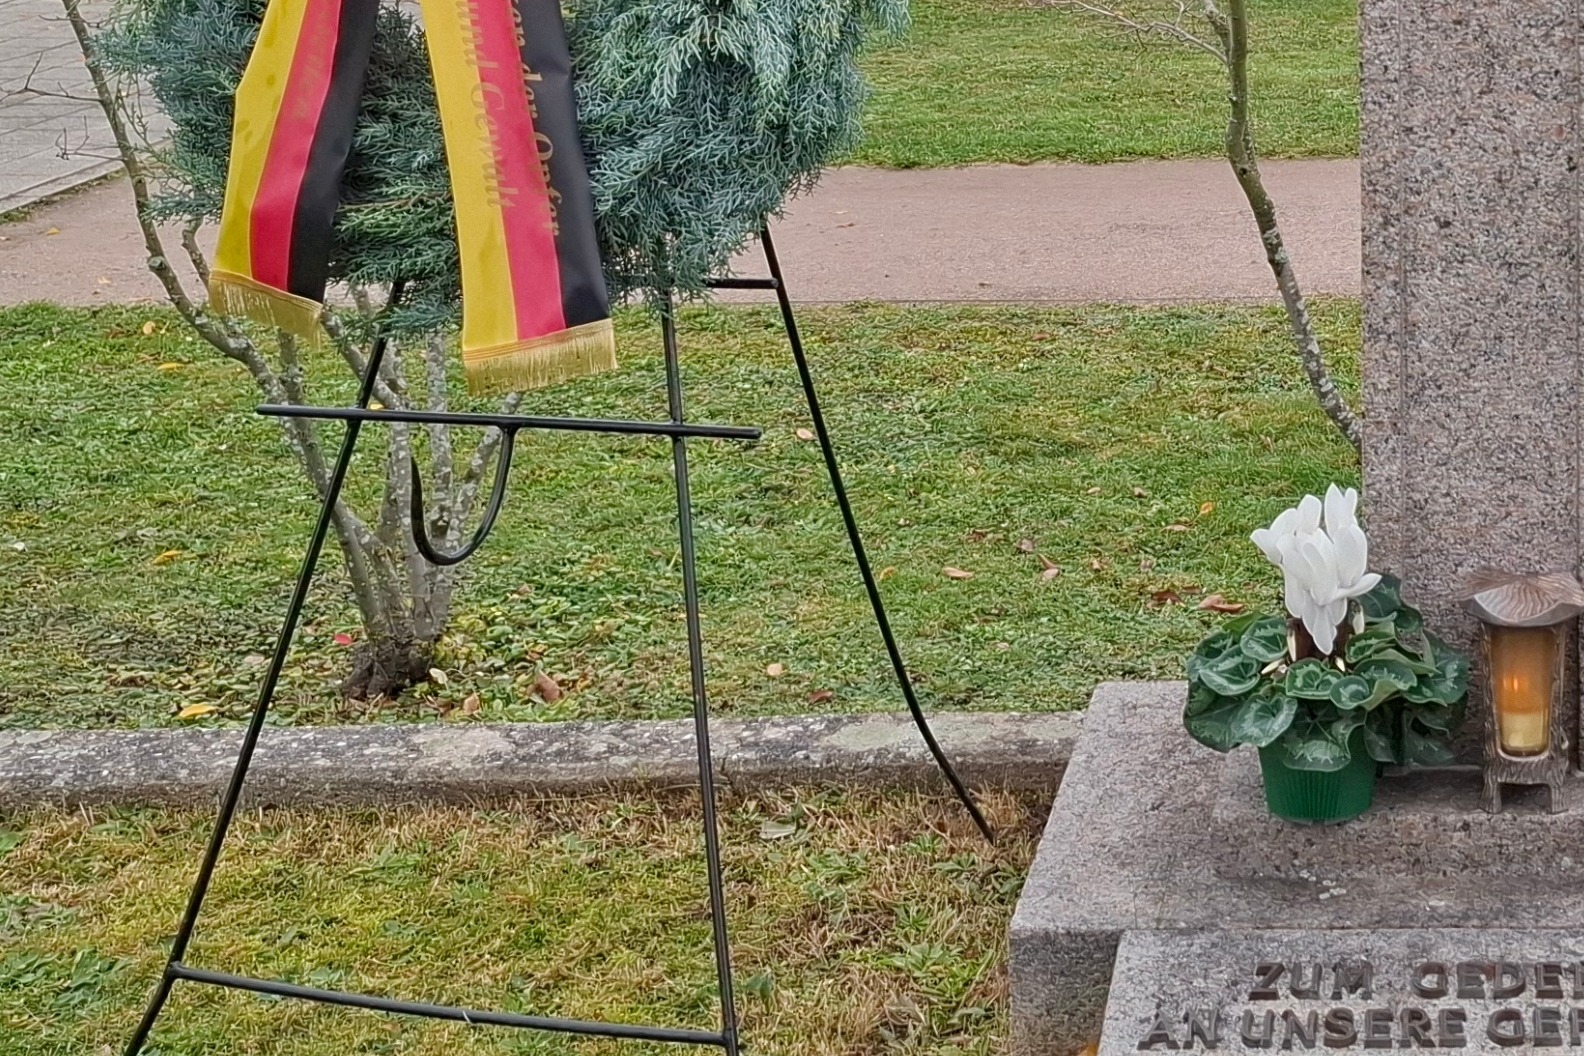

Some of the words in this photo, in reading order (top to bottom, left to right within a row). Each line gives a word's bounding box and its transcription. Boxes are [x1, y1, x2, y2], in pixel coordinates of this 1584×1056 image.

[456, 0, 500, 70] und
[515, 61, 543, 120] der
[470, 80, 519, 209] Gewalt
[526, 131, 563, 237] Opfer
[1248, 960, 1375, 1001] ZUM
[1135, 1006, 1219, 1051] AN
[1240, 1006, 1470, 1051] UNSERE
